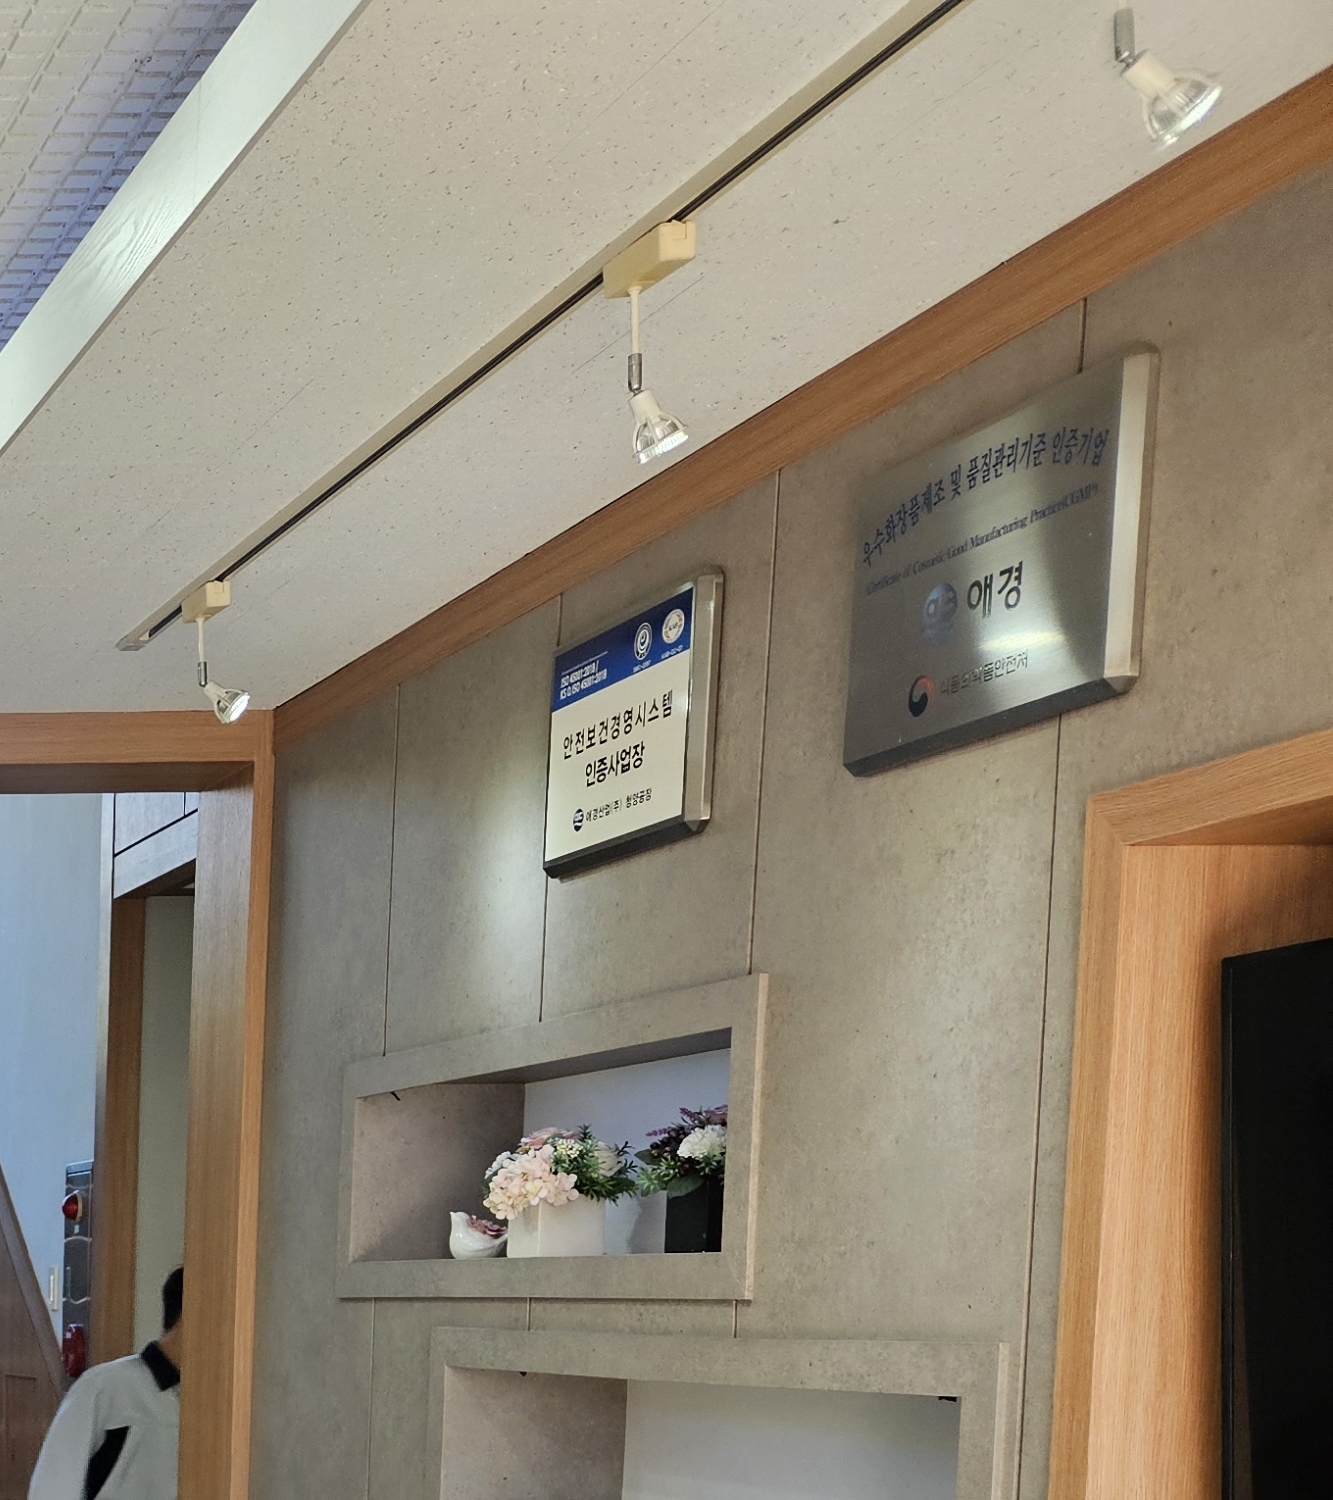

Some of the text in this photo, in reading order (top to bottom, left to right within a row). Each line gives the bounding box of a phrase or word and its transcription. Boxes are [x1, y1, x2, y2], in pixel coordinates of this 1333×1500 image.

[950, 464, 964, 501] 및
[966, 431, 1050, 490] 품질관리기준
[1052, 426, 1109, 467] 인증기업
[966, 561, 1024, 620] 애경
[563, 690, 673, 760] 안전보건경영시스템
[585, 740, 645, 788] 인증사업장
[585, 787, 653, 823] 애경산업(주) 청양공장
